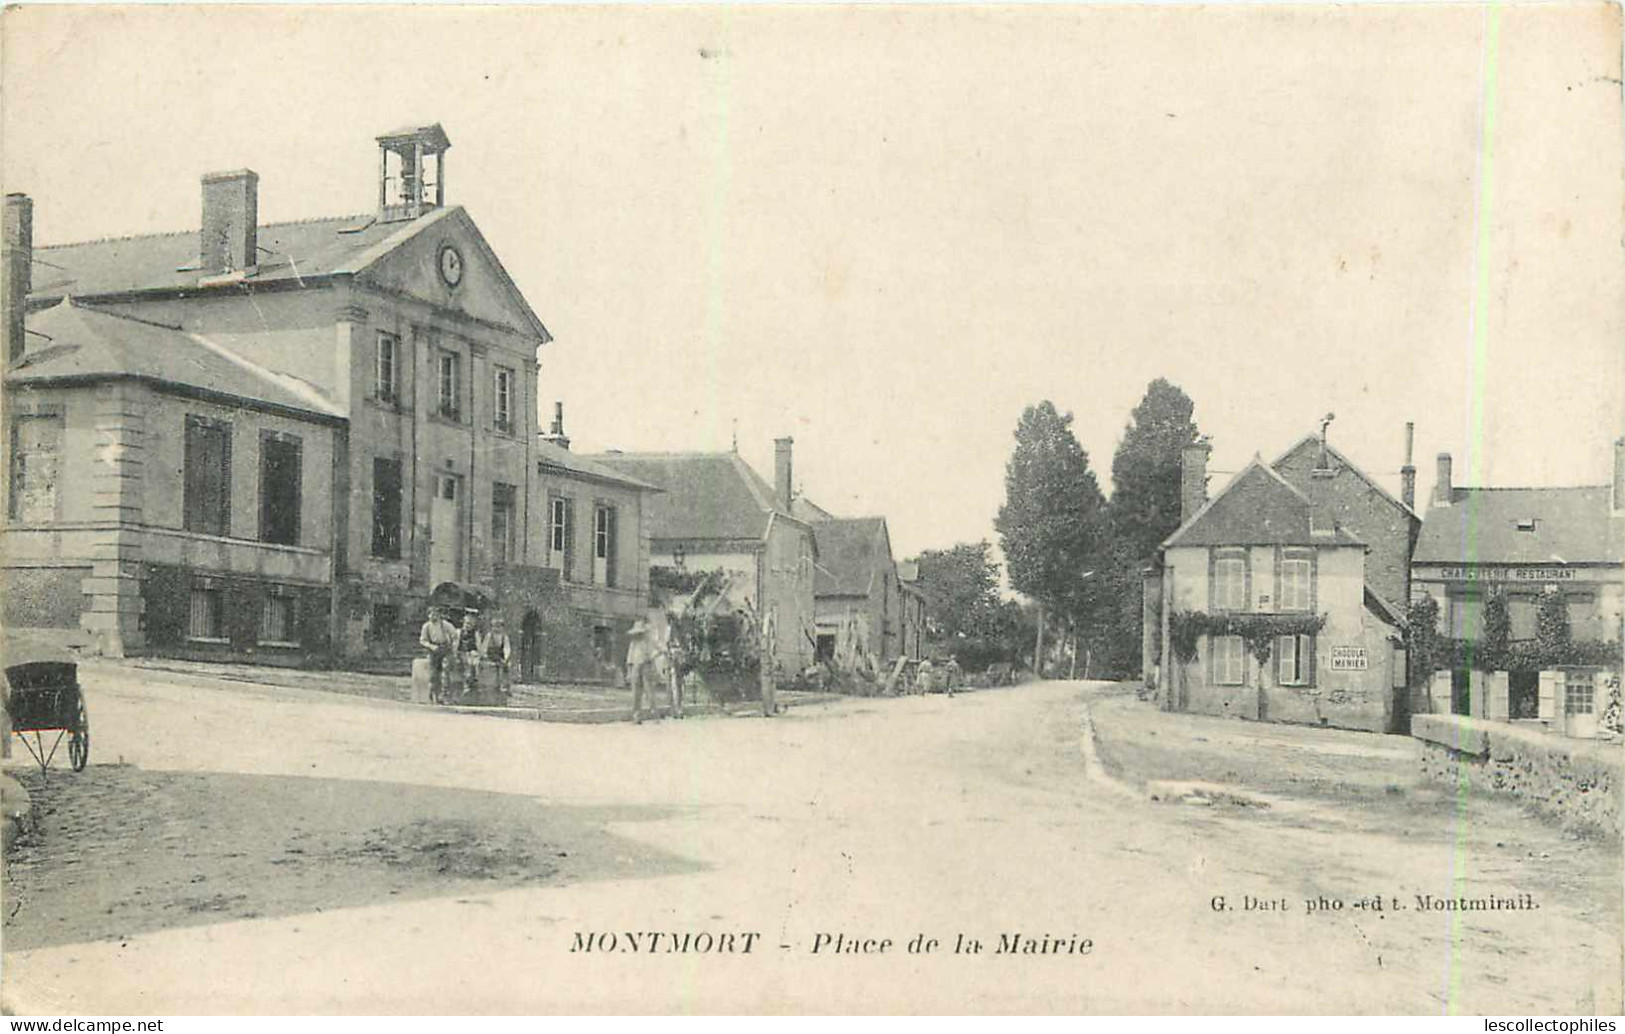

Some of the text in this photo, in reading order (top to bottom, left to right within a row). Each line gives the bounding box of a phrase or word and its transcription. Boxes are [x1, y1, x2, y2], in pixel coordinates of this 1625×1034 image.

[1516, 567, 1577, 579] RESTAURANT
[1211, 895, 1233, 912] G.
[1415, 894, 1541, 912] Montmirail.
[570, 932, 761, 954] MONTMORT
[811, 932, 893, 954] Place
[907, 932, 939, 954] de
[954, 932, 983, 954] la
[995, 932, 1094, 954] Mairie
